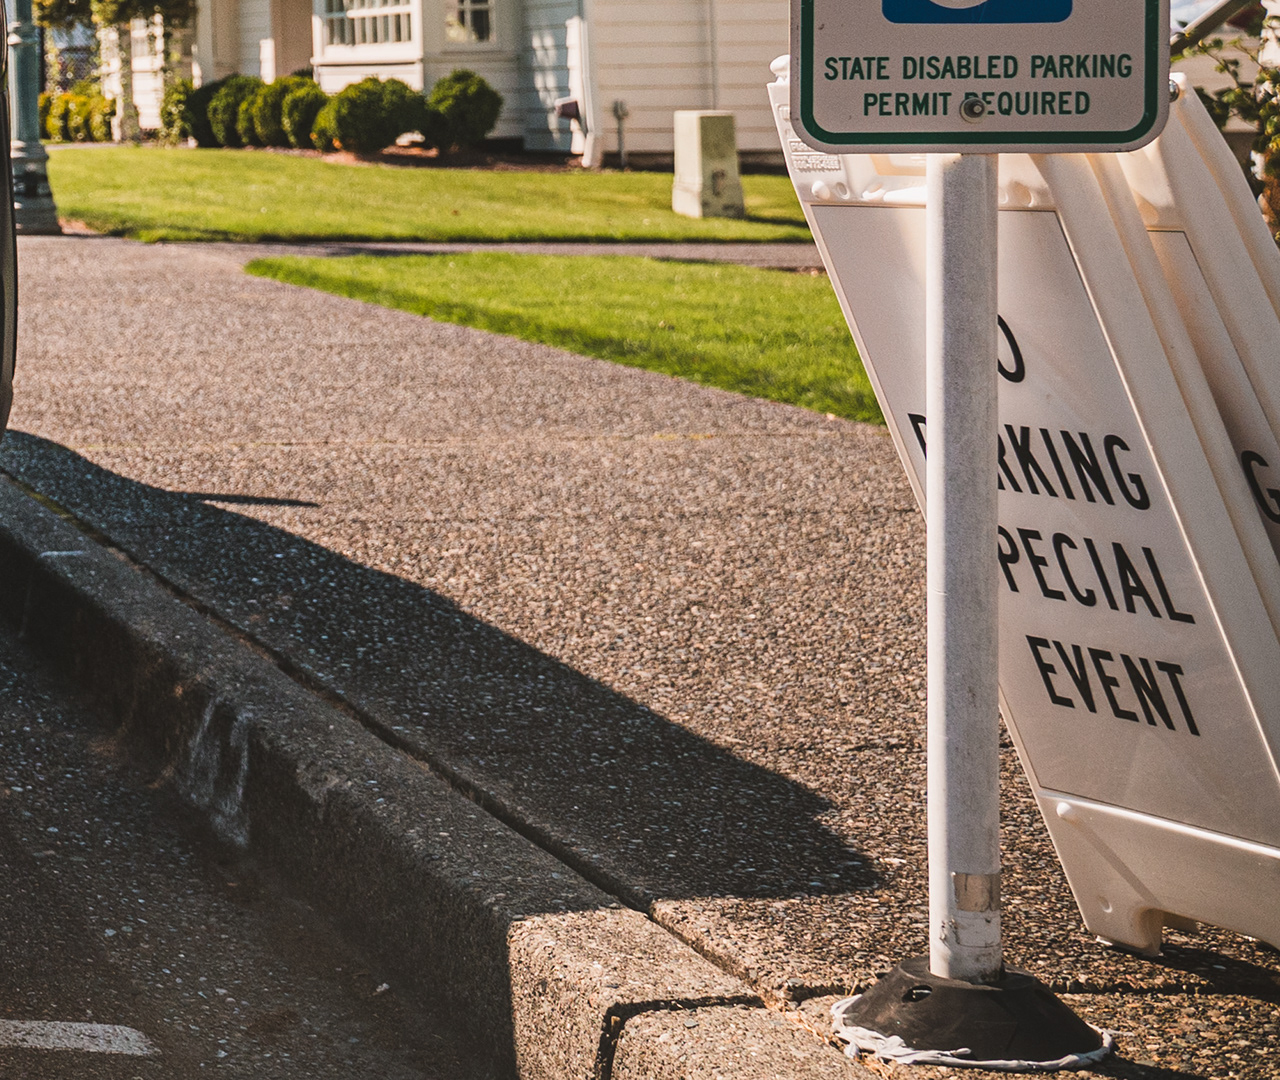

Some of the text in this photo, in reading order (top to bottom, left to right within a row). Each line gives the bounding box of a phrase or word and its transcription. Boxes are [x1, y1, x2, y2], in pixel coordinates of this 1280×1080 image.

[824, 54, 1133, 80] STATE DISABLED PARKING
[863, 91, 1091, 116] PERMIT EQUIRED
[997, 524, 1196, 624] PECIAL
[1025, 635, 1201, 737] EVENT
